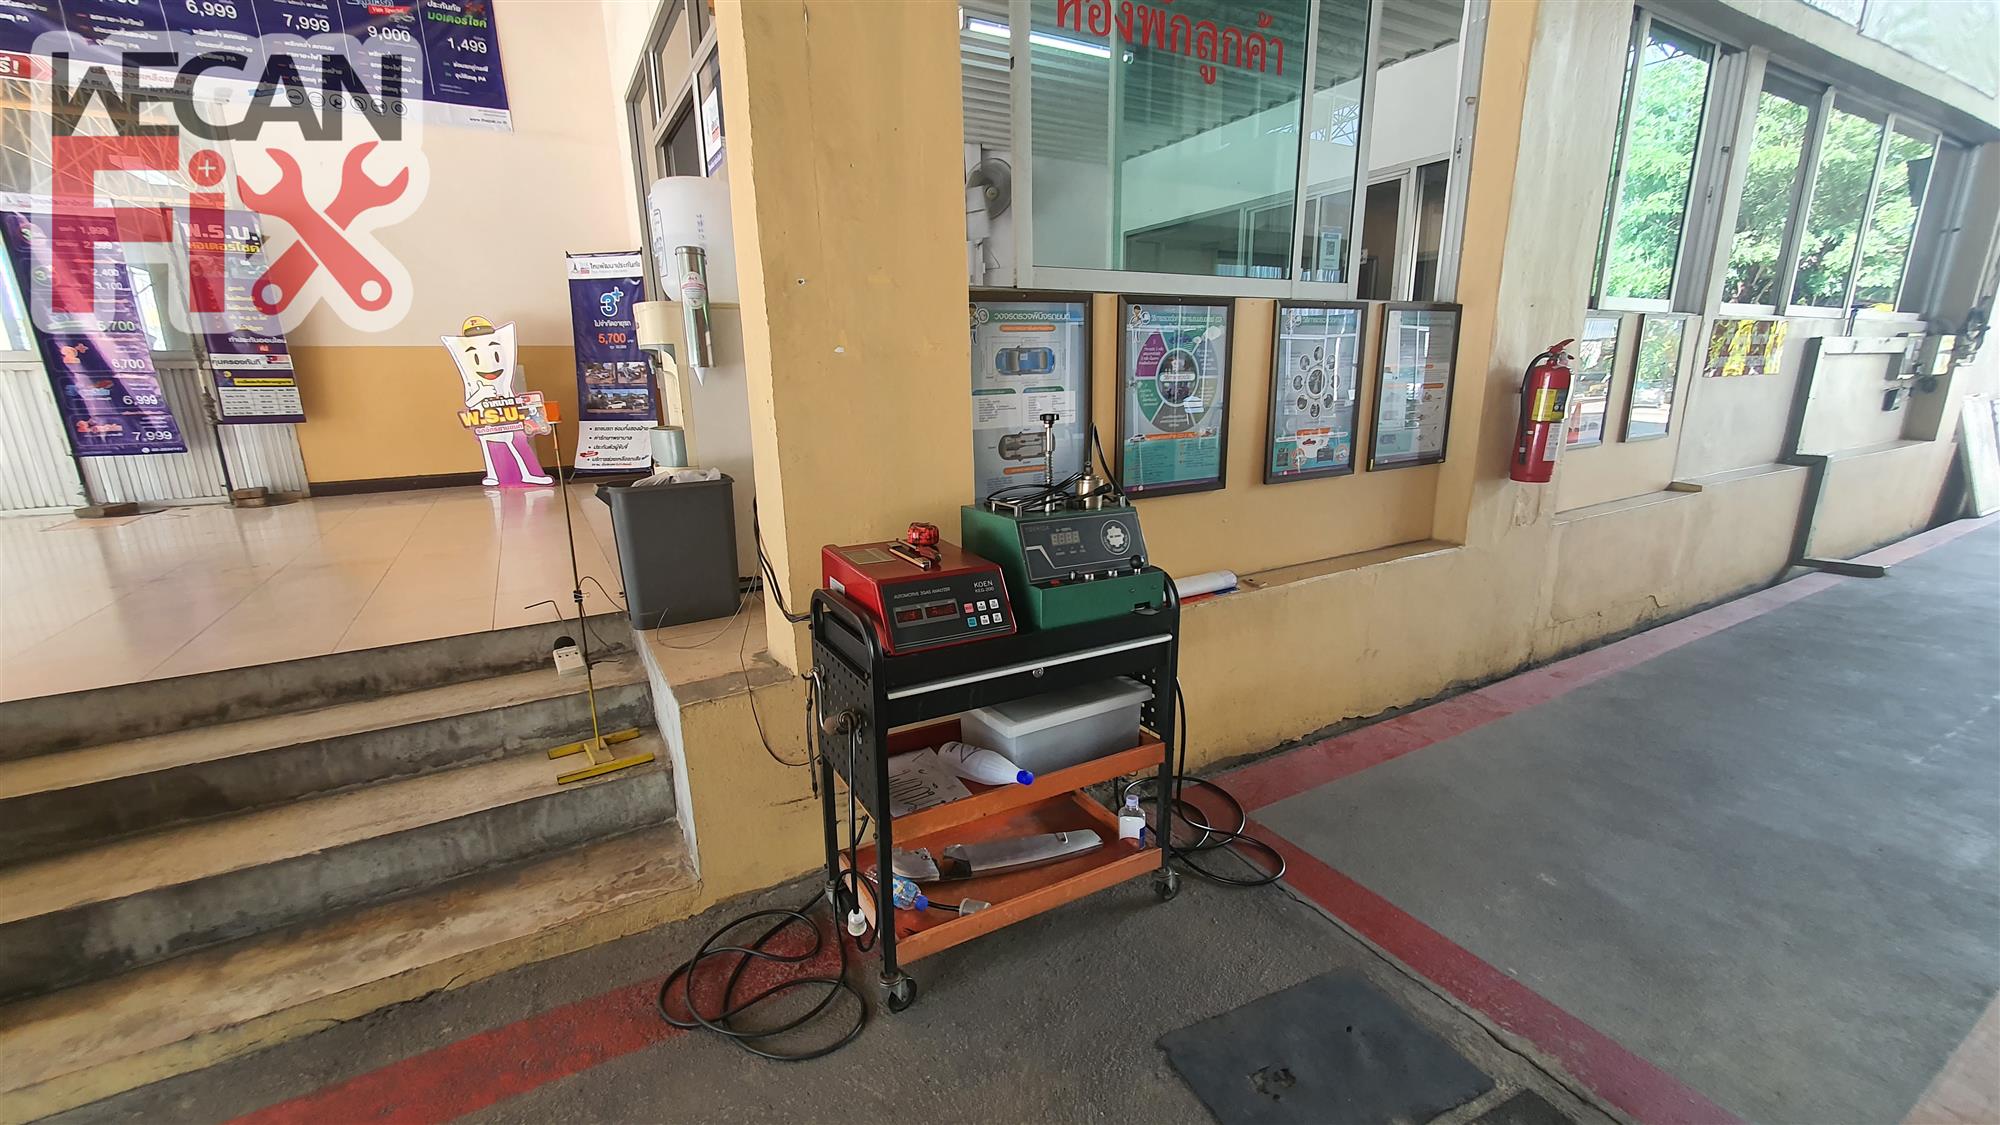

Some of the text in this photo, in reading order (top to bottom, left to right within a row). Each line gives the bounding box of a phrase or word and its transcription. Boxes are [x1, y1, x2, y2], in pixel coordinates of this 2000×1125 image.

[186, 0, 237, 20] 6,999
[283, 13, 331, 32] 7,999
[427, 12, 487, 28] มอเตอร์ไซค์
[367, 25, 411, 43] 9,000
[447, 37, 488, 54] 1,499
[598, 332, 627, 344] 5,700
[112, 358, 145, 370] 6,700
[122, 394, 158, 406] 6,999
[459, 406, 526, 427] พ.ร.บ.
[132, 430, 173, 442] 7,999
